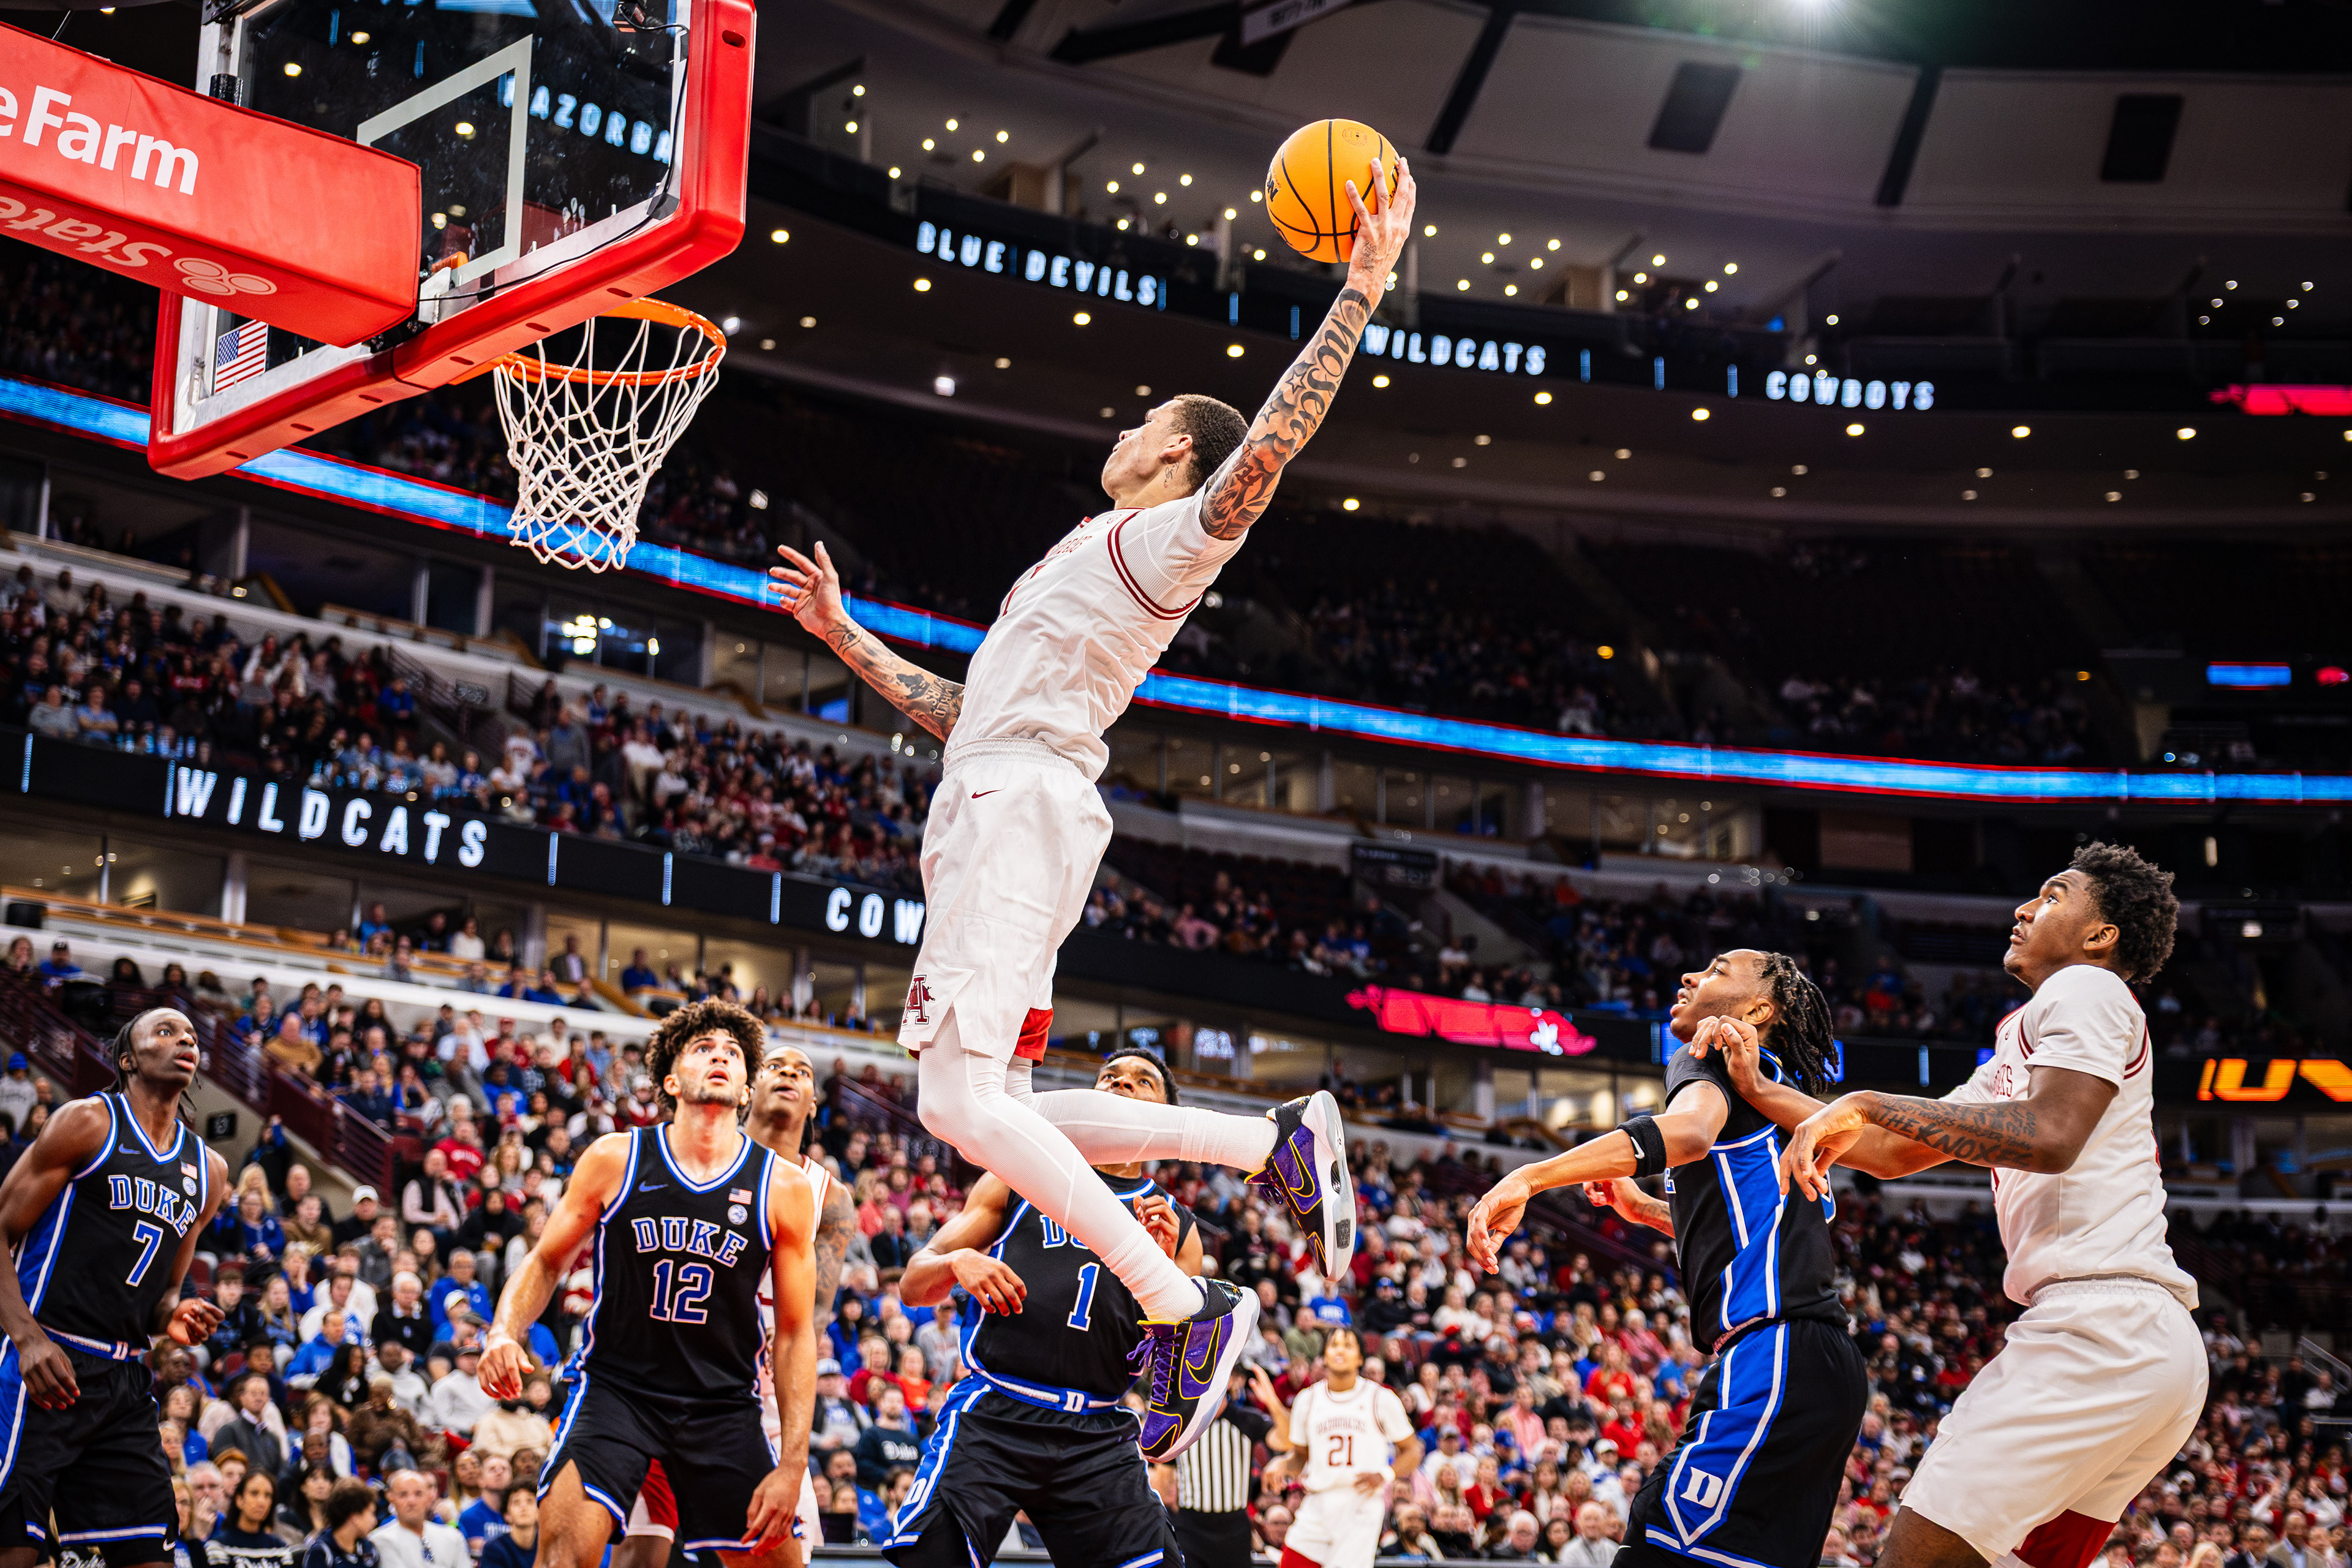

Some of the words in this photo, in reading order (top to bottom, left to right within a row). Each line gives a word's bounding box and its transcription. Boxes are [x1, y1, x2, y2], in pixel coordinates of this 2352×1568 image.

[917, 221, 1006, 274] BLUE
[1025, 250, 1157, 306] DEVILS
[1365, 324, 1546, 375] WILDCATS
[1766, 371, 1934, 410] COWBOYS
[176, 767, 487, 867] WILDCATS
[826, 888, 925, 945] COW
[108, 1174, 197, 1238] DUKE
[126, 1219, 164, 1287] 7
[631, 1216, 748, 1268] DUKE
[649, 1259, 715, 1324] 12
[1067, 1262, 1100, 1332] 1
[1063, 1391, 1085, 1412] D
[1328, 1435, 1352, 1466] 21
[1680, 1466, 1723, 1508] D
